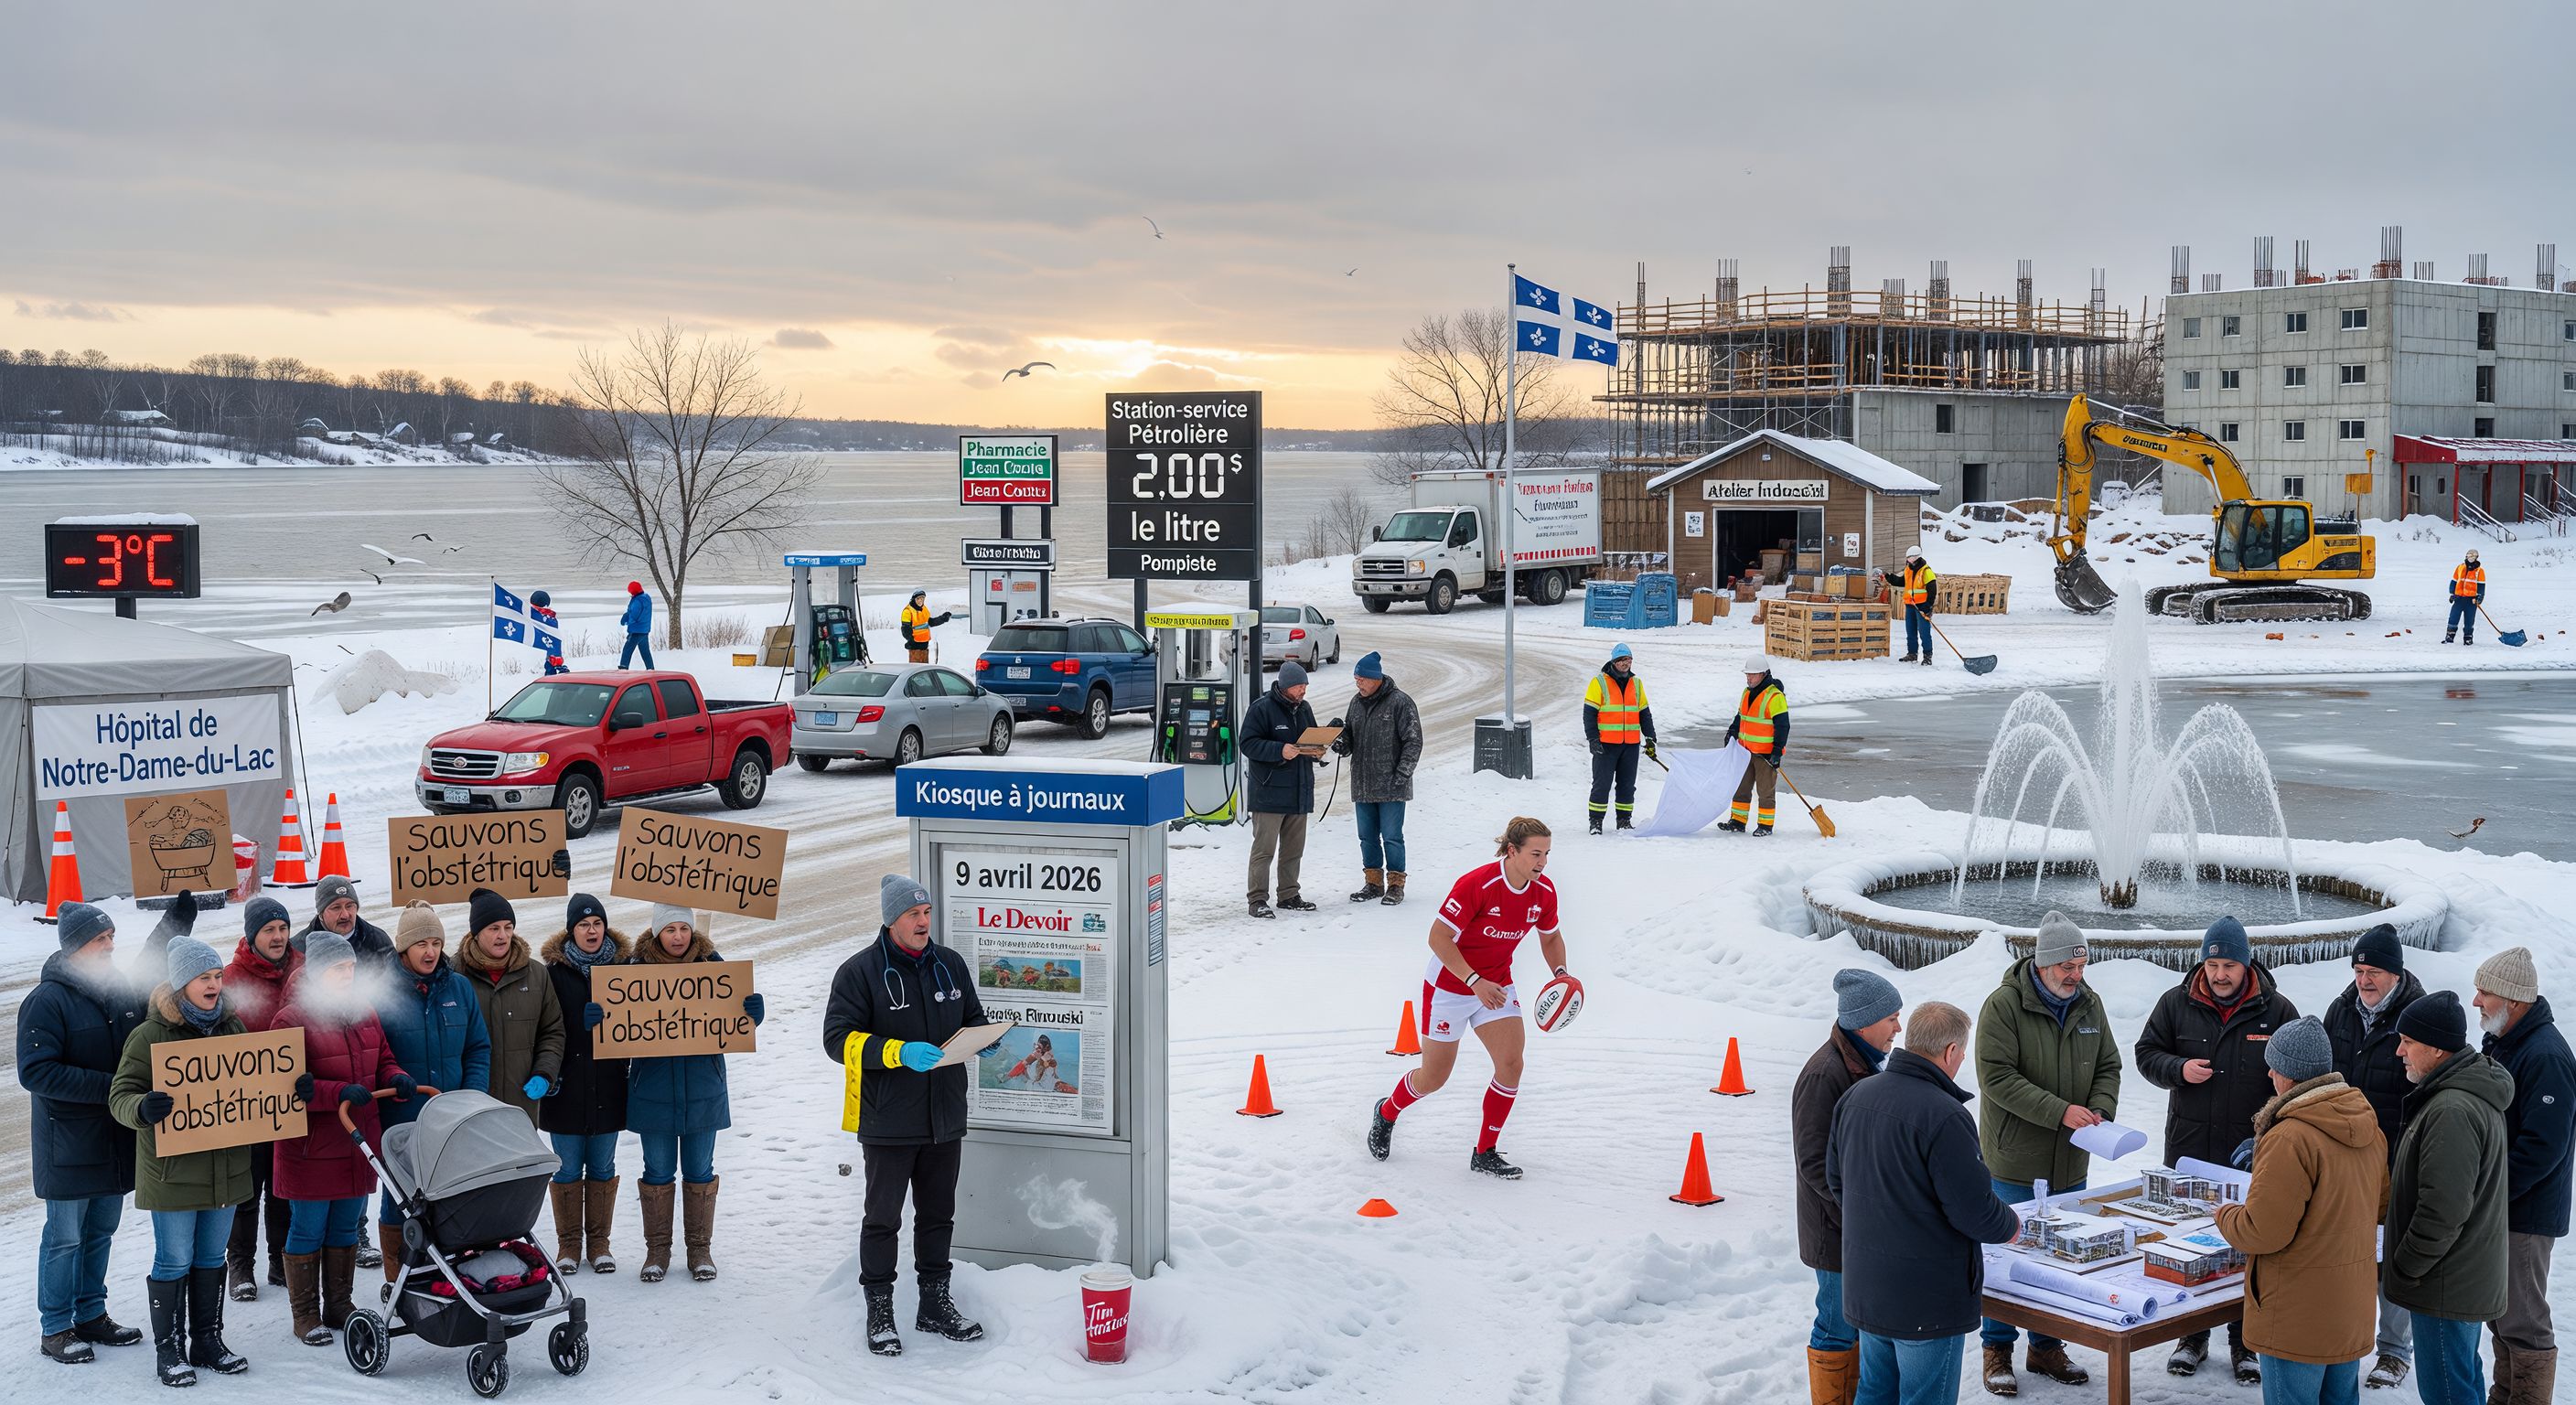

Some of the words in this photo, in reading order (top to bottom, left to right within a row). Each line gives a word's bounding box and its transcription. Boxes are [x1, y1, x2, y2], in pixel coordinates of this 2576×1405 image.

[1111, 399, 1248, 420] Station-service
[1129, 423, 1229, 445] Pétrolière
[966, 441, 1047, 456] Pharmacie
[967, 482, 1000, 499] Jean
[1131, 510, 1156, 542] le
[1165, 510, 1221, 542] litre
[1140, 553, 1217, 575] Pompiste
[95, 709, 182, 750] Hôpital
[188, 708, 218, 737] de
[42, 744, 275, 788] Notre-Dame-du-Lac
[916, 780, 1003, 811] Kiosque
[1008, 783, 1022, 808] à
[1026, 784, 1125, 813] journaux
[618, 845, 778, 909] l'obstétrique
[956, 861, 971, 886] 9
[978, 863, 1033, 889] avril
[1040, 864, 1102, 893] 2026
[977, 906, 1003, 928] Le
[1005, 907, 1073, 931] Devoir
